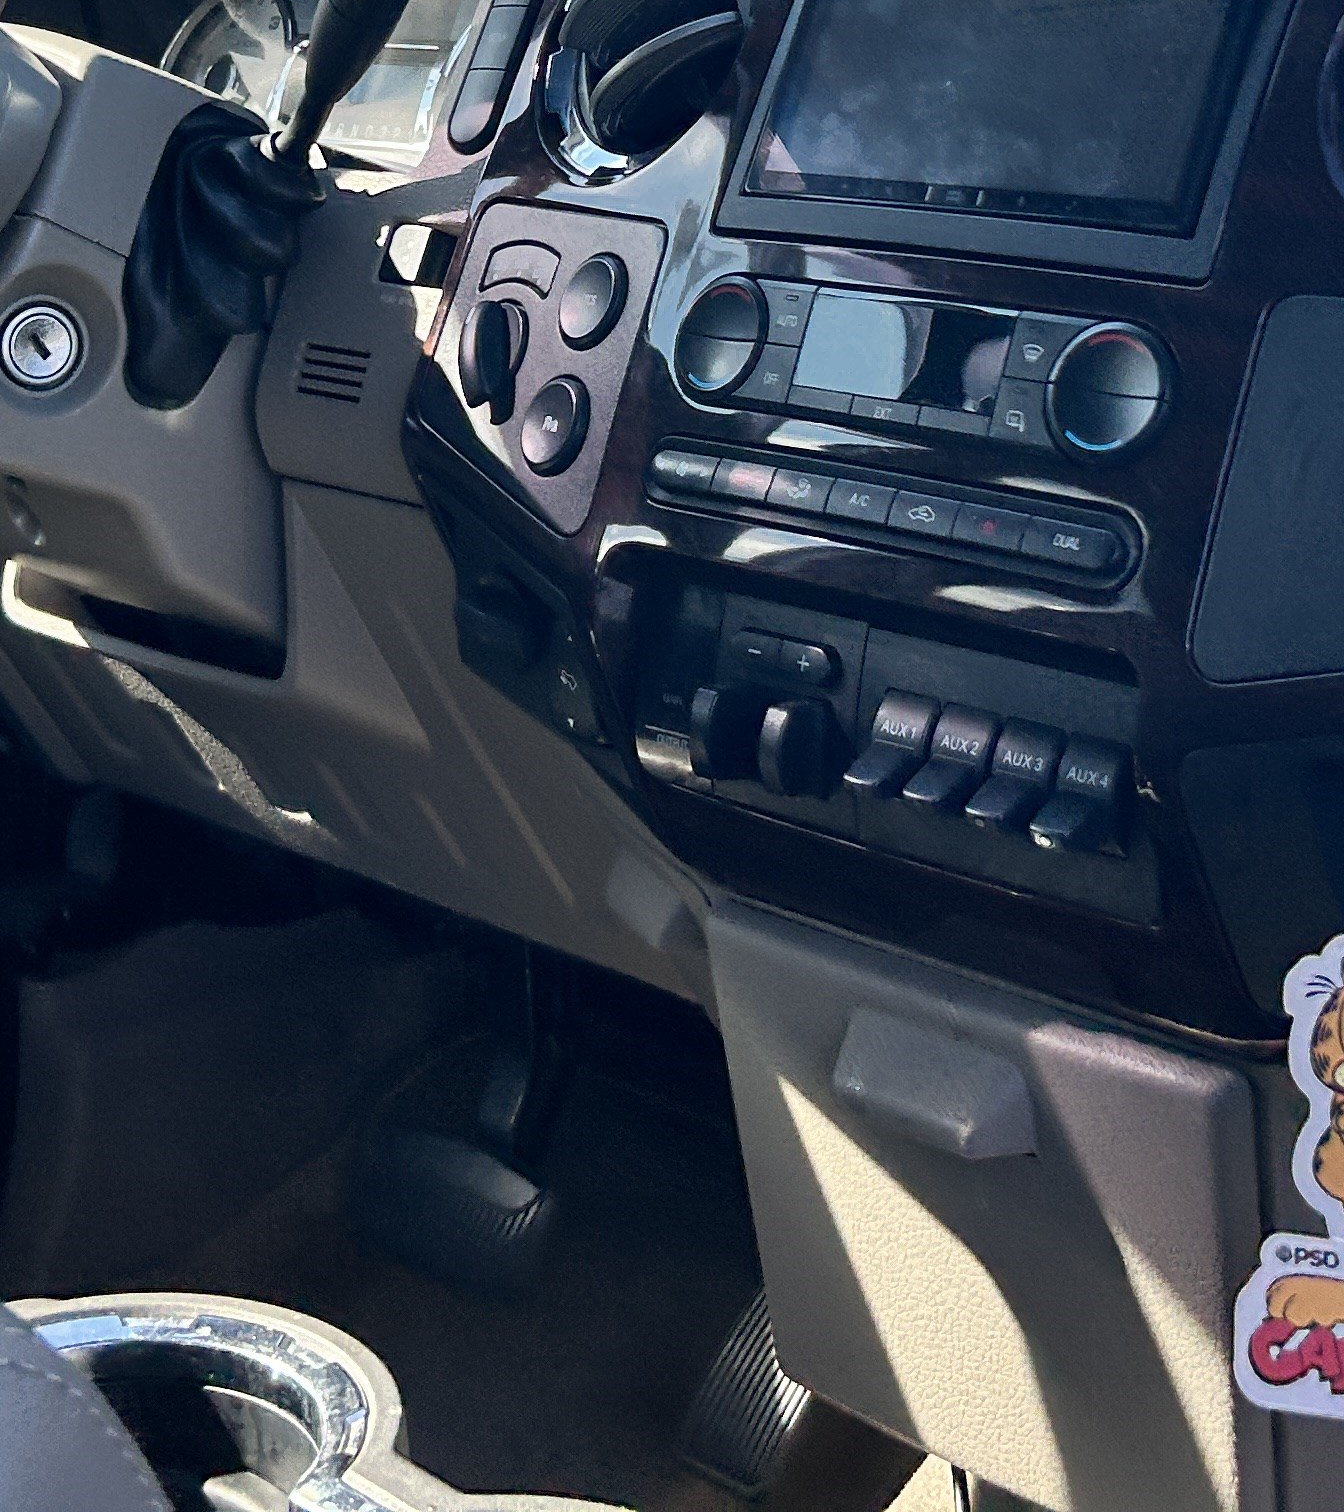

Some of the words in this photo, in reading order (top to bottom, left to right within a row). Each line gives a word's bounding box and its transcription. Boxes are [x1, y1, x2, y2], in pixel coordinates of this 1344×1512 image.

[1053, 533, 1080, 551] DUAL
[880, 719, 907, 738] AUX
[940, 734, 968, 754] AUX
[969, 740, 979, 756] 2
[1002, 750, 1033, 770] AUX
[1034, 756, 1044, 771] 3
[1066, 766, 1097, 787] AUX
